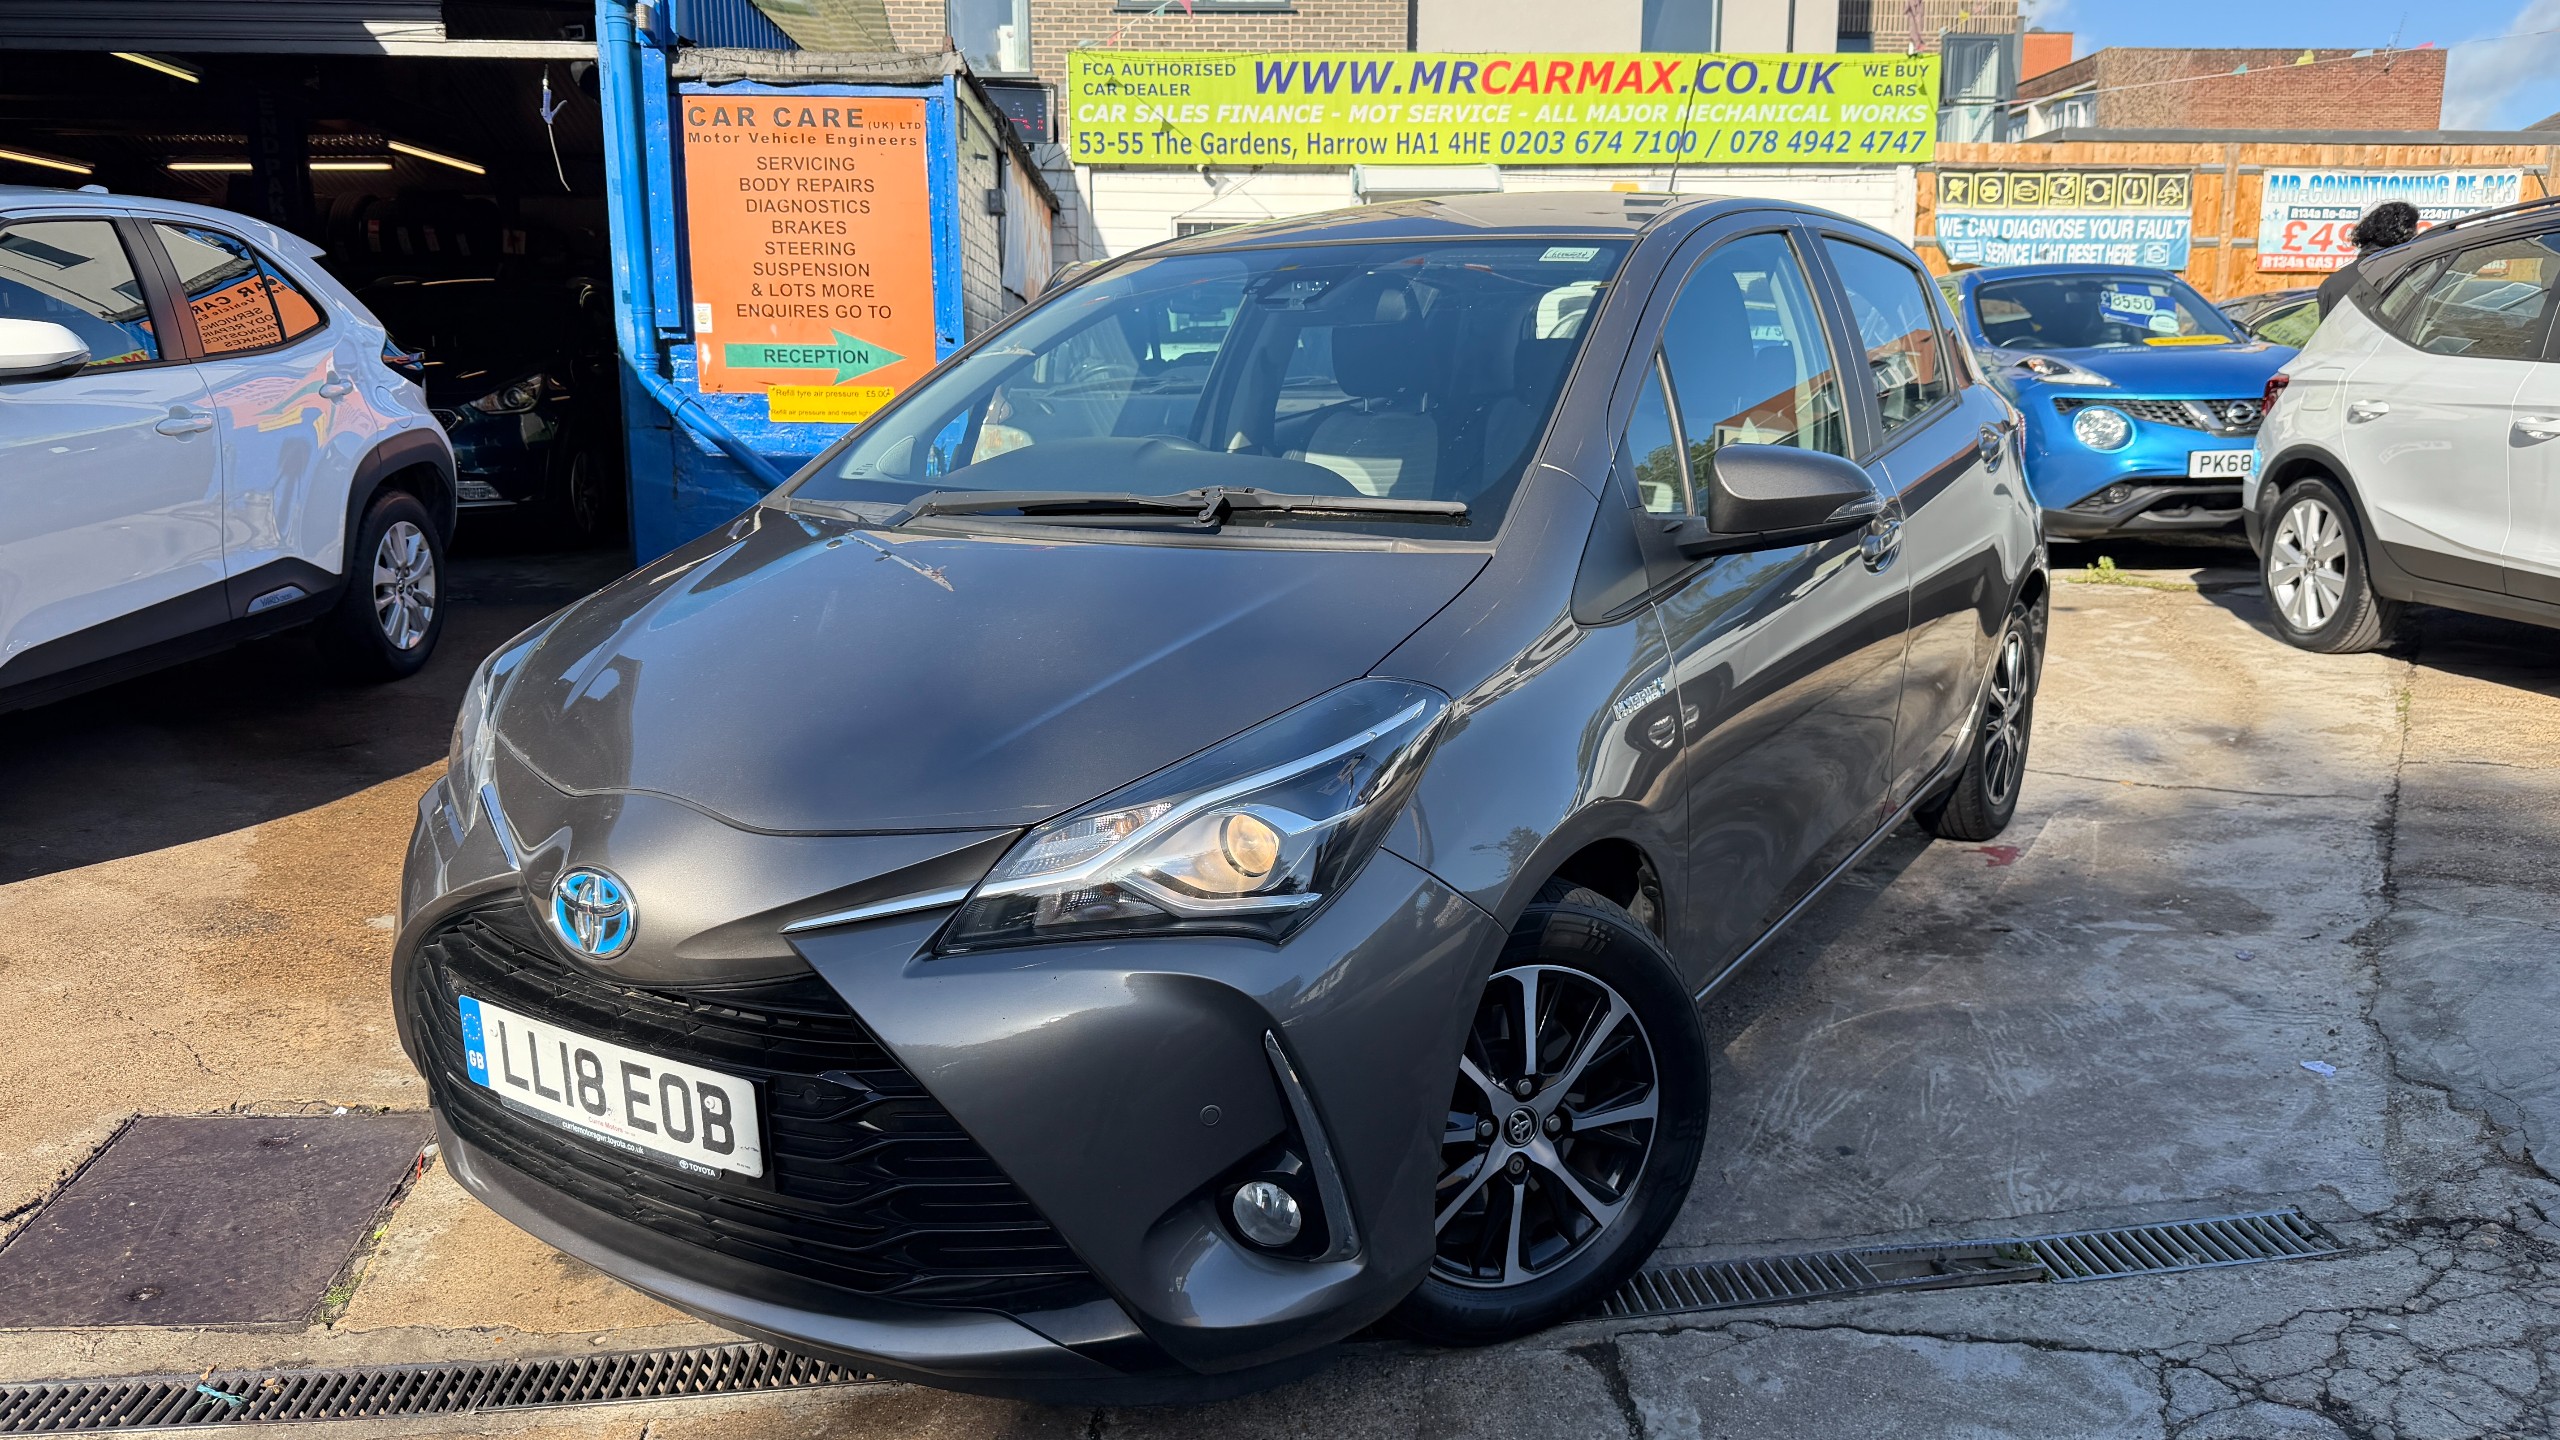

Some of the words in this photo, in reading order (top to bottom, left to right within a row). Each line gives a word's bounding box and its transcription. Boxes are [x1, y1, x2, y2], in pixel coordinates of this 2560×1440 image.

[1083, 62, 1117, 77] FCA
[1122, 62, 1236, 77] AUTHORISED
[1255, 59, 1842, 95] WWW.MRCARMAX.CO.UK
[1863, 64, 1888, 77] WE
[1895, 64, 1929, 77] BUY
[1083, 82, 1117, 97] CAR
[1125, 83, 1191, 97] DEALER
[1873, 84, 1916, 97] CARS
[688, 106, 757, 128] CAR
[773, 107, 865, 129] CARE
[868, 120, 895, 131] (UK)
[900, 121, 922, 131] LTD
[1078, 104, 1127, 123] CAR
[1133, 104, 1212, 123] SALES
[1216, 104, 1323, 123] FINANCE
[1349, 104, 1403, 123] MOT
[1407, 104, 1509, 123] SERVICE
[1534, 104, 1578, 123] ALL
[1585, 104, 1668, 123] MAJOR
[1675, 104, 1830, 123] MECHANICAL
[1840, 104, 1927, 123] WORKS
[688, 132, 740, 145] Motor
[750, 132, 817, 145] Vehicle
[826, 133, 918, 148] Engineers
[1079, 132, 1143, 155] 53-55
[1152, 132, 1192, 155] The
[1200, 132, 1298, 160] Gardens,
[1307, 132, 1388, 155] Harrow
[1397, 132, 1439, 155] HA1
[1449, 131, 1490, 155] 4HE
[1500, 131, 1564, 155] 0203
[1575, 131, 1622, 154] 674
[1632, 131, 1697, 154] 7100
[1729, 131, 1778, 154] 078
[1786, 131, 1850, 154] 4942
[1860, 131, 1927, 154] 4747
[756, 155, 856, 172] SERVICING
[739, 177, 790, 193] BODY
[797, 177, 875, 194] REPAIRS
[2267, 174, 2449, 205] AIR-CONDITIONING
[2455, 174, 2518, 204] RE-GAS
[746, 198, 871, 215] DIAGNOSTICS
[2419, 207, 2453, 220] 1234yf
[772, 219, 848, 236] BRAKES
[1939, 217, 1965, 238] WE
[1968, 218, 1999, 239] CAN
[2002, 218, 2085, 240] DIAGNOSE
[2089, 218, 2133, 240] YOUR
[2136, 218, 2187, 240] FAULT
[764, 240, 857, 257] STEERING
[1985, 242, 2029, 264] SERVICE
[2032, 242, 2067, 264] LIGHT
[2069, 243, 2103, 264] RESET
[2105, 243, 2138, 265] HERE
[753, 261, 871, 278] SUSPENSION
[2306, 255, 2334, 269] GAS
[751, 282, 763, 298] &
[769, 282, 817, 298] LOTS
[822, 283, 875, 298] MORE
[736, 302, 830, 320] ENQUIRES
[835, 303, 862, 320] GO
[867, 304, 893, 320] TO
[764, 348, 870, 365] RECEPTION
[776, 389, 795, 398] Refill
[797, 390, 812, 399] tyre
[814, 390, 823, 398] air
[826, 390, 860, 399] pressure
[798, 409, 826, 417] pressure
[2199, 454, 2252, 473] PK68
[469, 1049, 485, 1070] GB
[498, 1020, 607, 1117] LL18
[620, 1060, 735, 1157] EOB
[688, 1162, 716, 1177] TOYOTA
